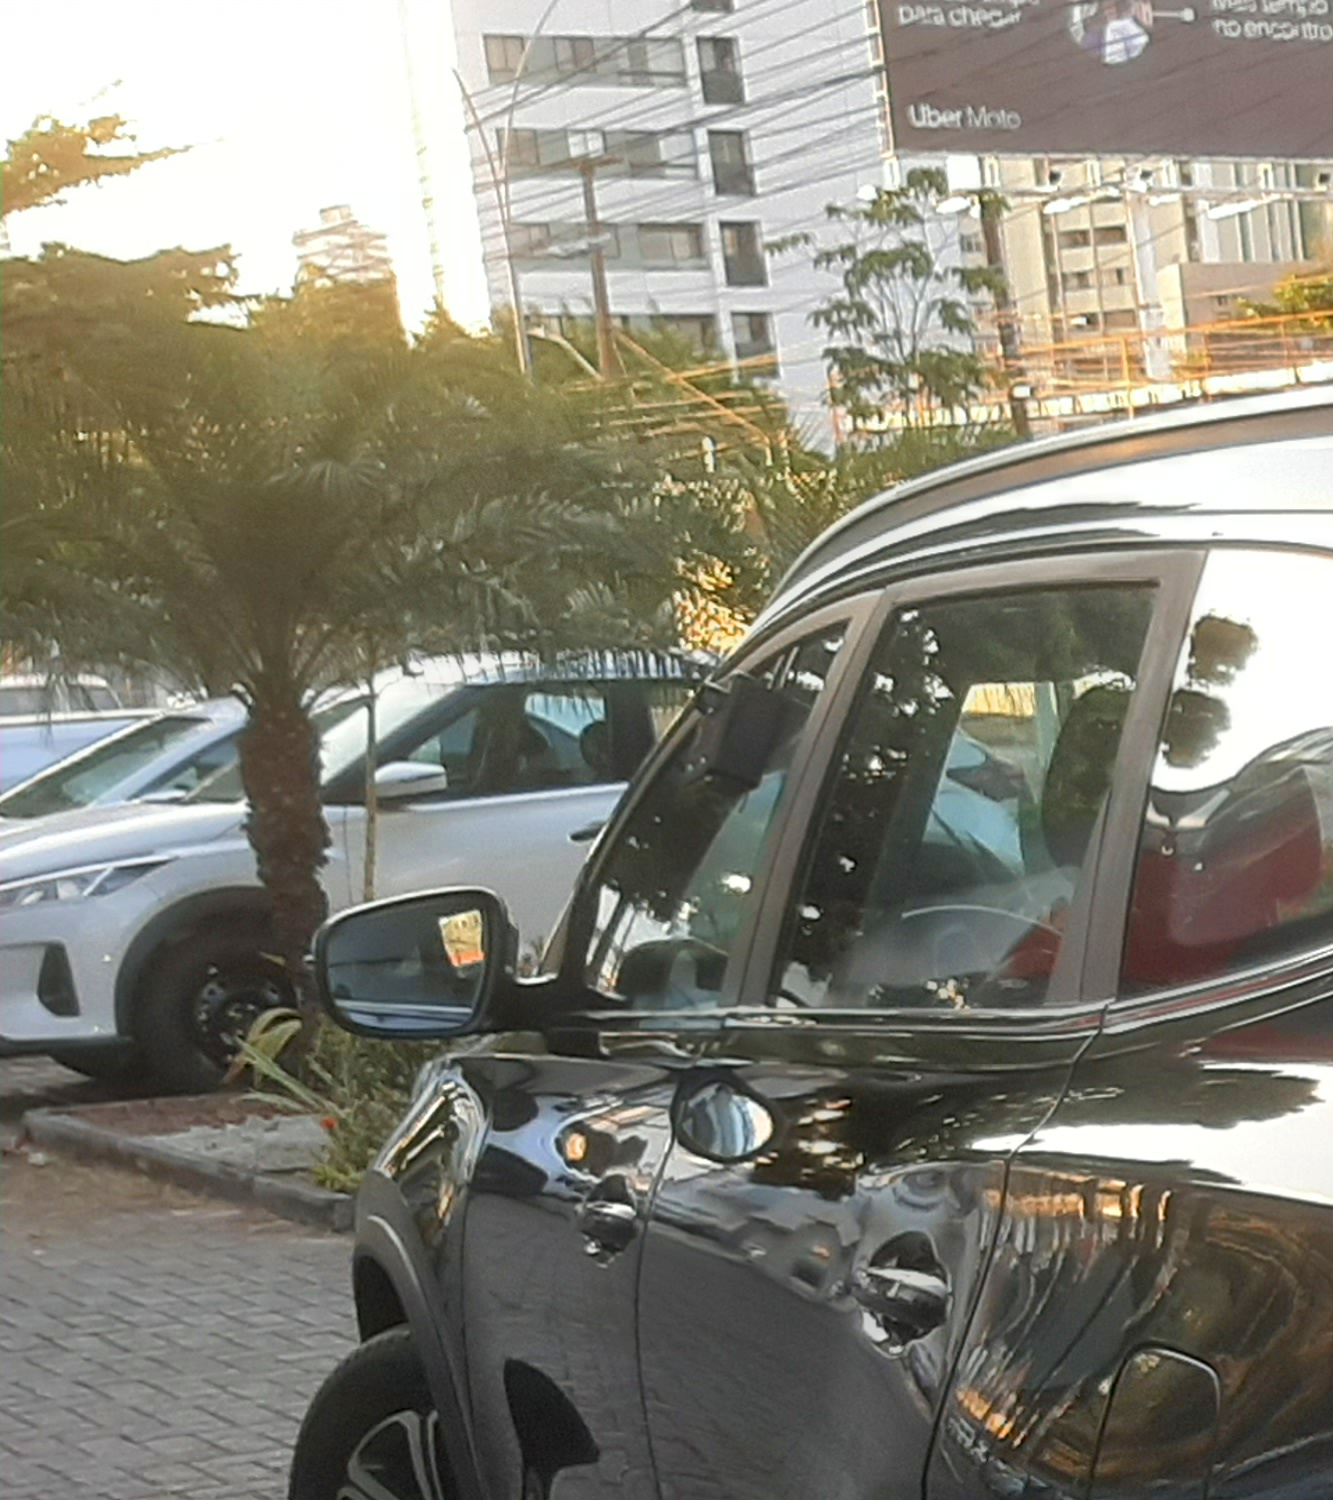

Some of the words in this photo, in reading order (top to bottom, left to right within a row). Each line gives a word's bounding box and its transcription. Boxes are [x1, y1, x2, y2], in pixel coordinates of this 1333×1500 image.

[900, 5, 946, 26] para
[1212, 18, 1242, 38] no
[909, 103, 962, 129] Uber
[965, 105, 1022, 130] Moto
